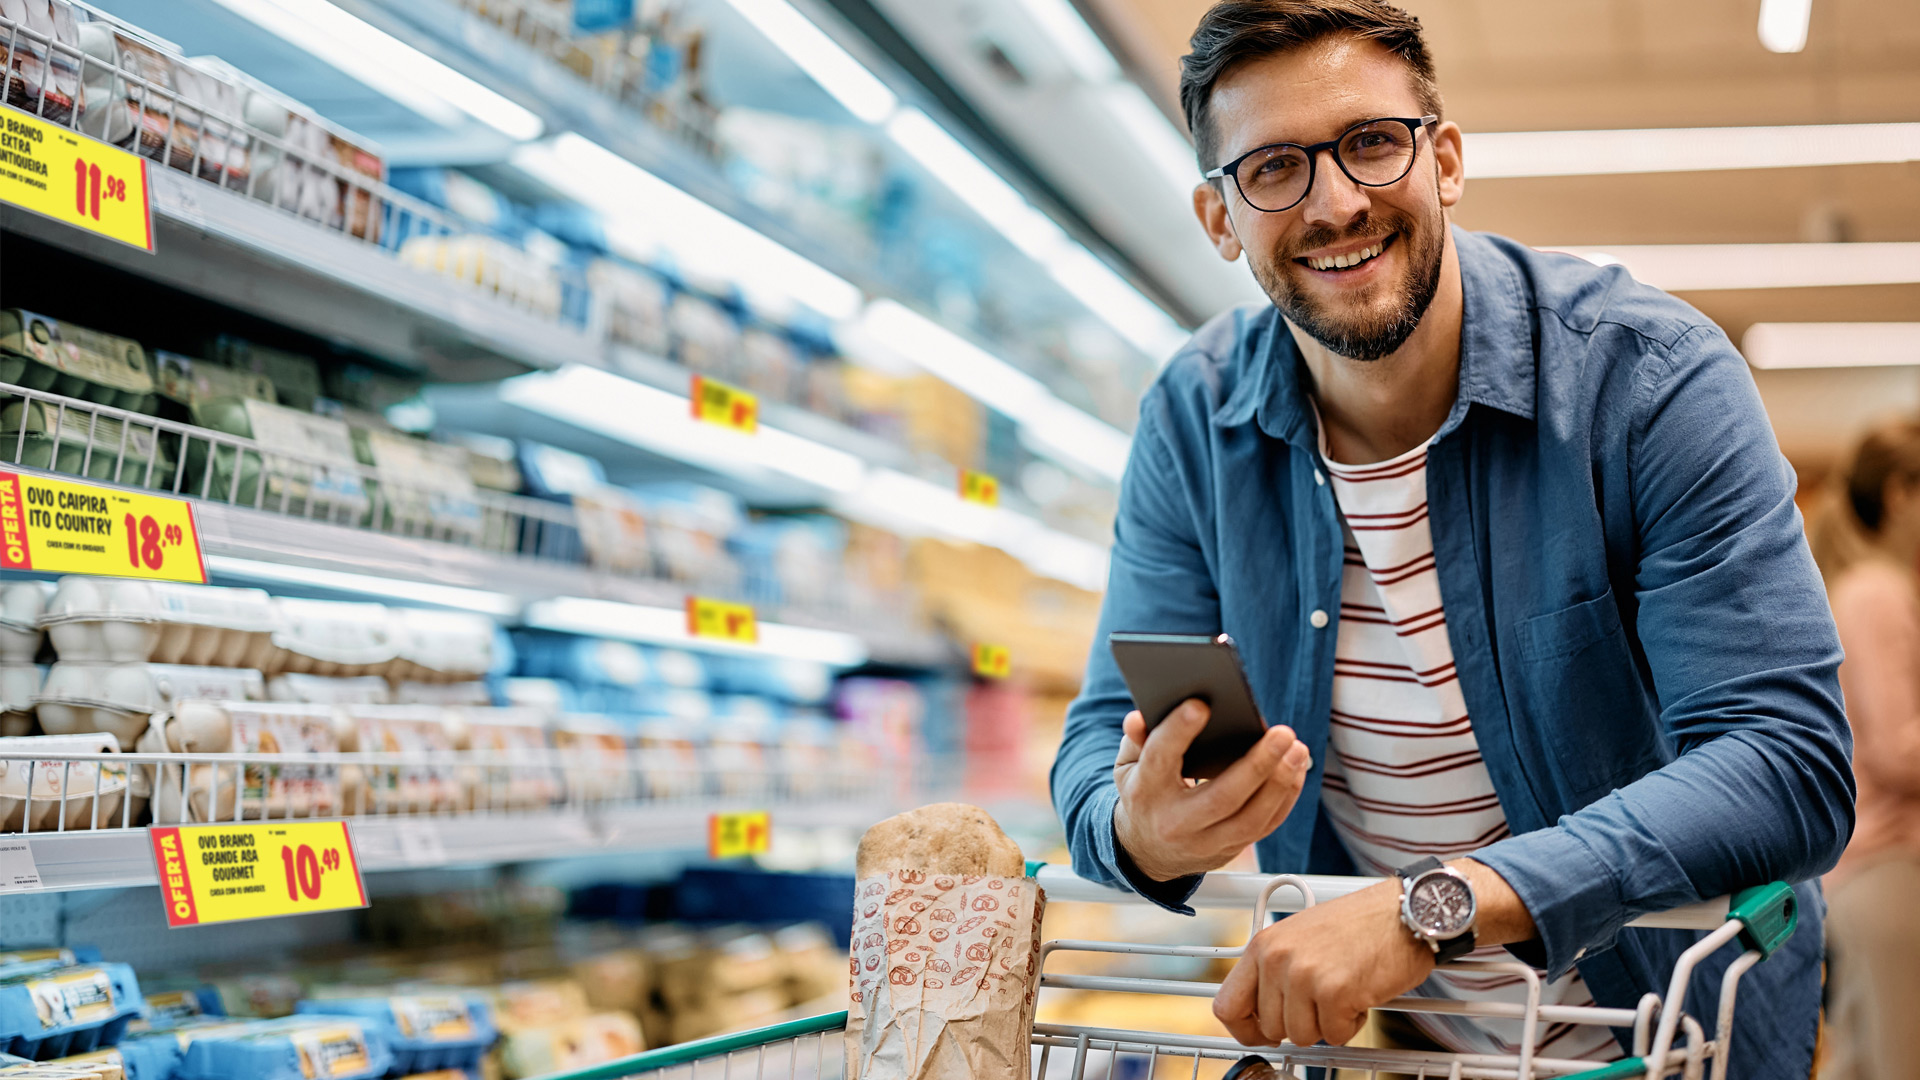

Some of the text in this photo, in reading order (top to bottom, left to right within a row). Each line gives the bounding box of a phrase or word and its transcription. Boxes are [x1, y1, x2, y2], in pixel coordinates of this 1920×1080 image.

[7, 118, 43, 143] BRANCO
[1, 133, 31, 155] EXTRA
[7, 171, 17, 180] COM
[27, 486, 55, 505] OVO
[58, 491, 108, 514] CAIPIRA
[0, 479, 25, 563] OFERTA
[29, 509, 112, 536] ITO COUNTRY
[198, 834, 255, 849] OVO BRANCO
[202, 849, 259, 865] GRANDE ASA
[160, 834, 191, 919] OFERTA
[212, 865, 255, 882] GOURMET
